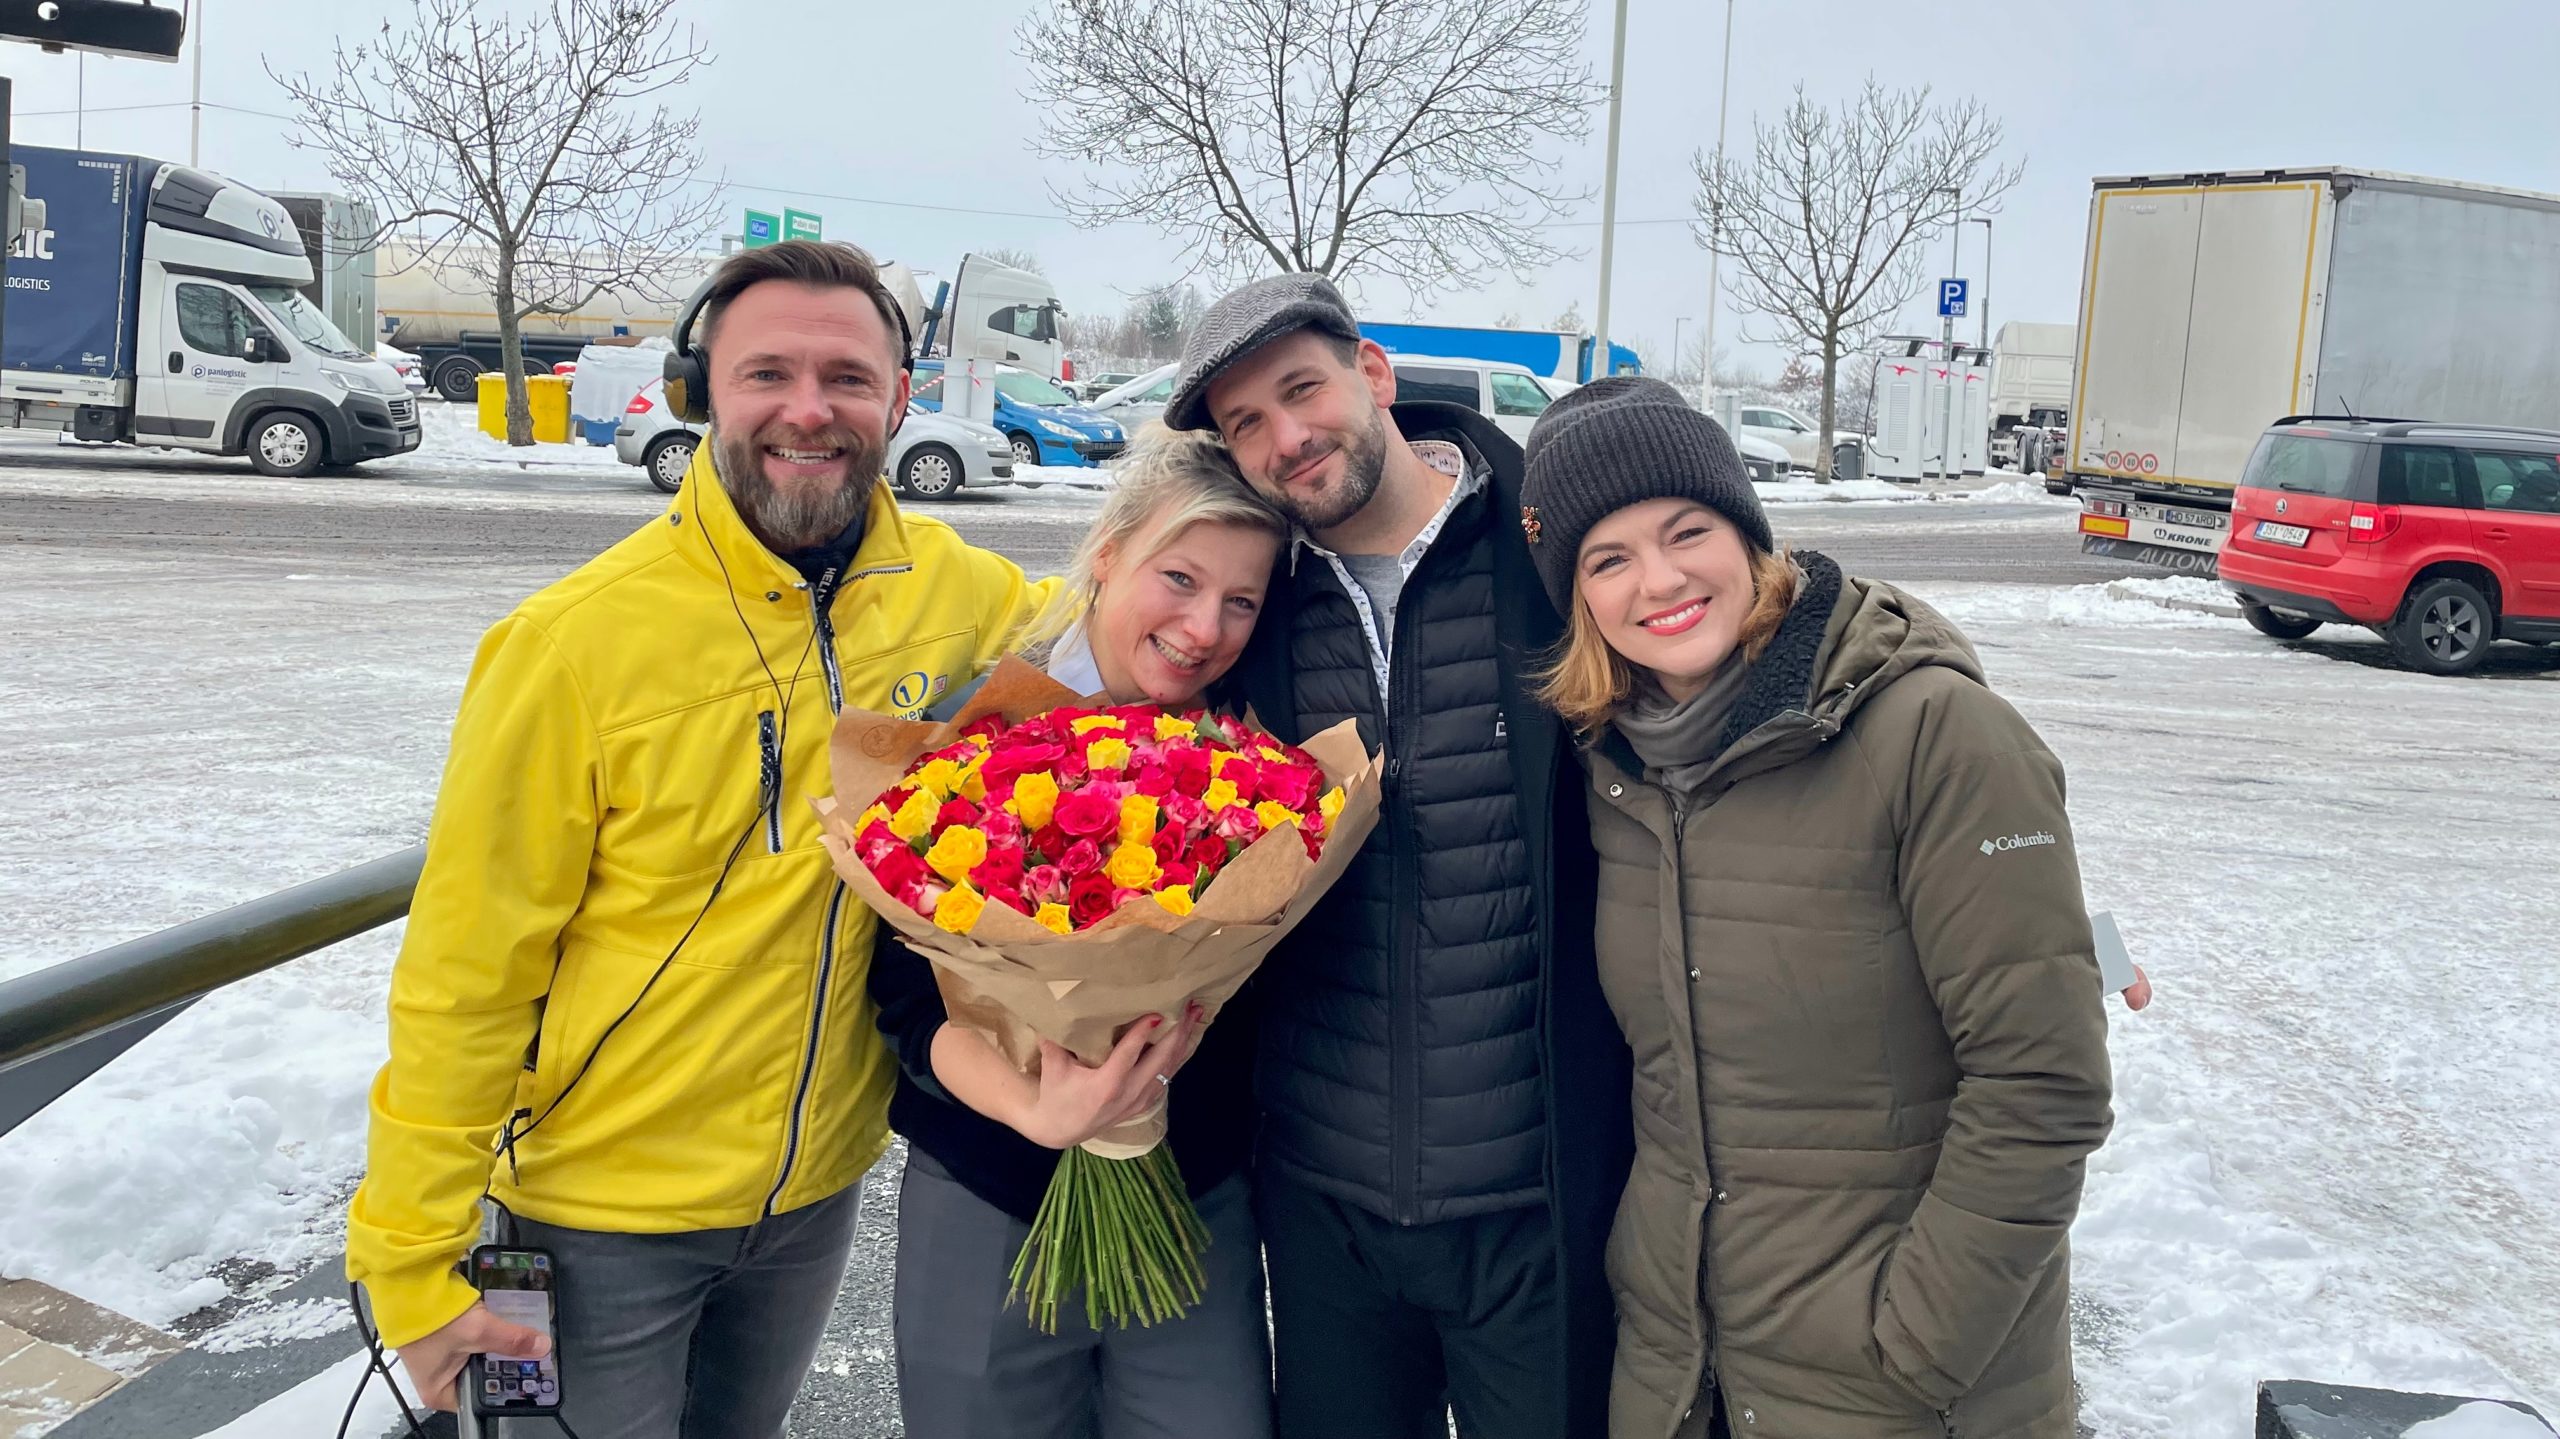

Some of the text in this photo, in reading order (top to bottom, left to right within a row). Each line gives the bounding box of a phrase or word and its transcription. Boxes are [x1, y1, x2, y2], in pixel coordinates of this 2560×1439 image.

[1945, 283, 1962, 305] P
[207, 368, 247, 378] panlogistic
[2110, 456, 2118, 465] 70
[2167, 533, 2212, 547] KRONE
[1996, 831, 2056, 851] Columbia
